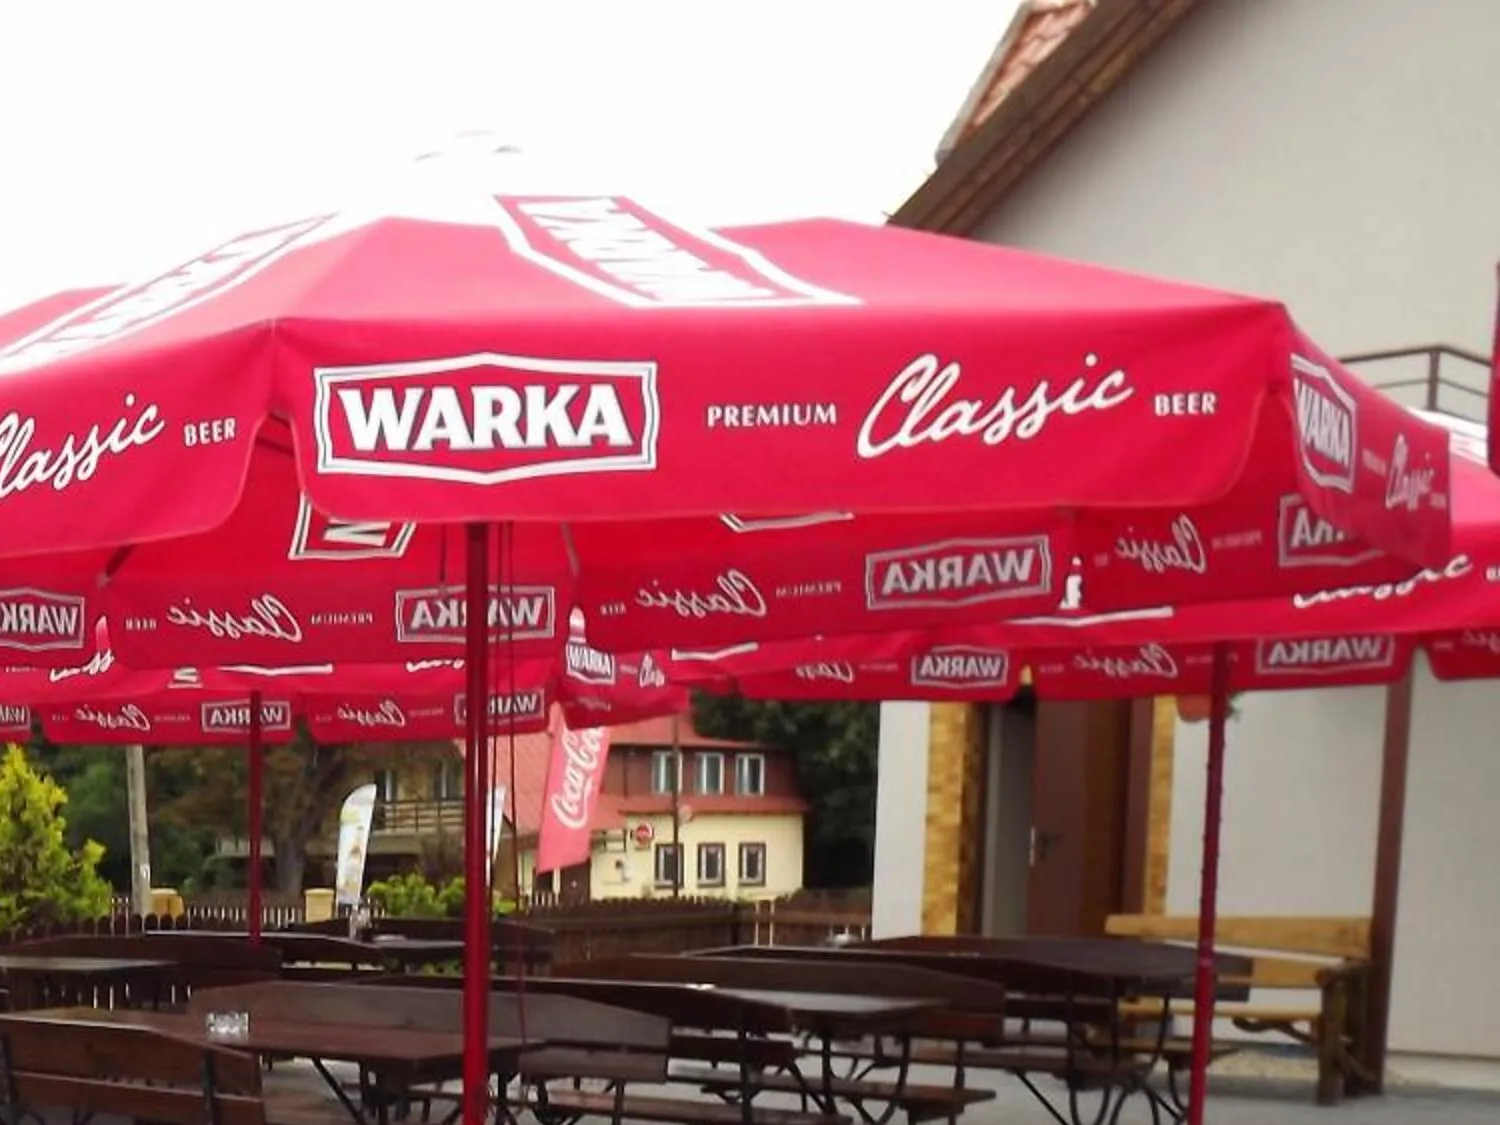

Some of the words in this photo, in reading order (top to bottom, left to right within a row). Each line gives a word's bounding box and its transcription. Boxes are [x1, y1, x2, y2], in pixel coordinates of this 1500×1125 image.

[183, 417, 237, 447] BEER
[337, 382, 634, 452] WARKA
[706, 402, 838, 428] PREMIUM
[856, 353, 1134, 459] Classic
[1154, 391, 1217, 417] BEER
